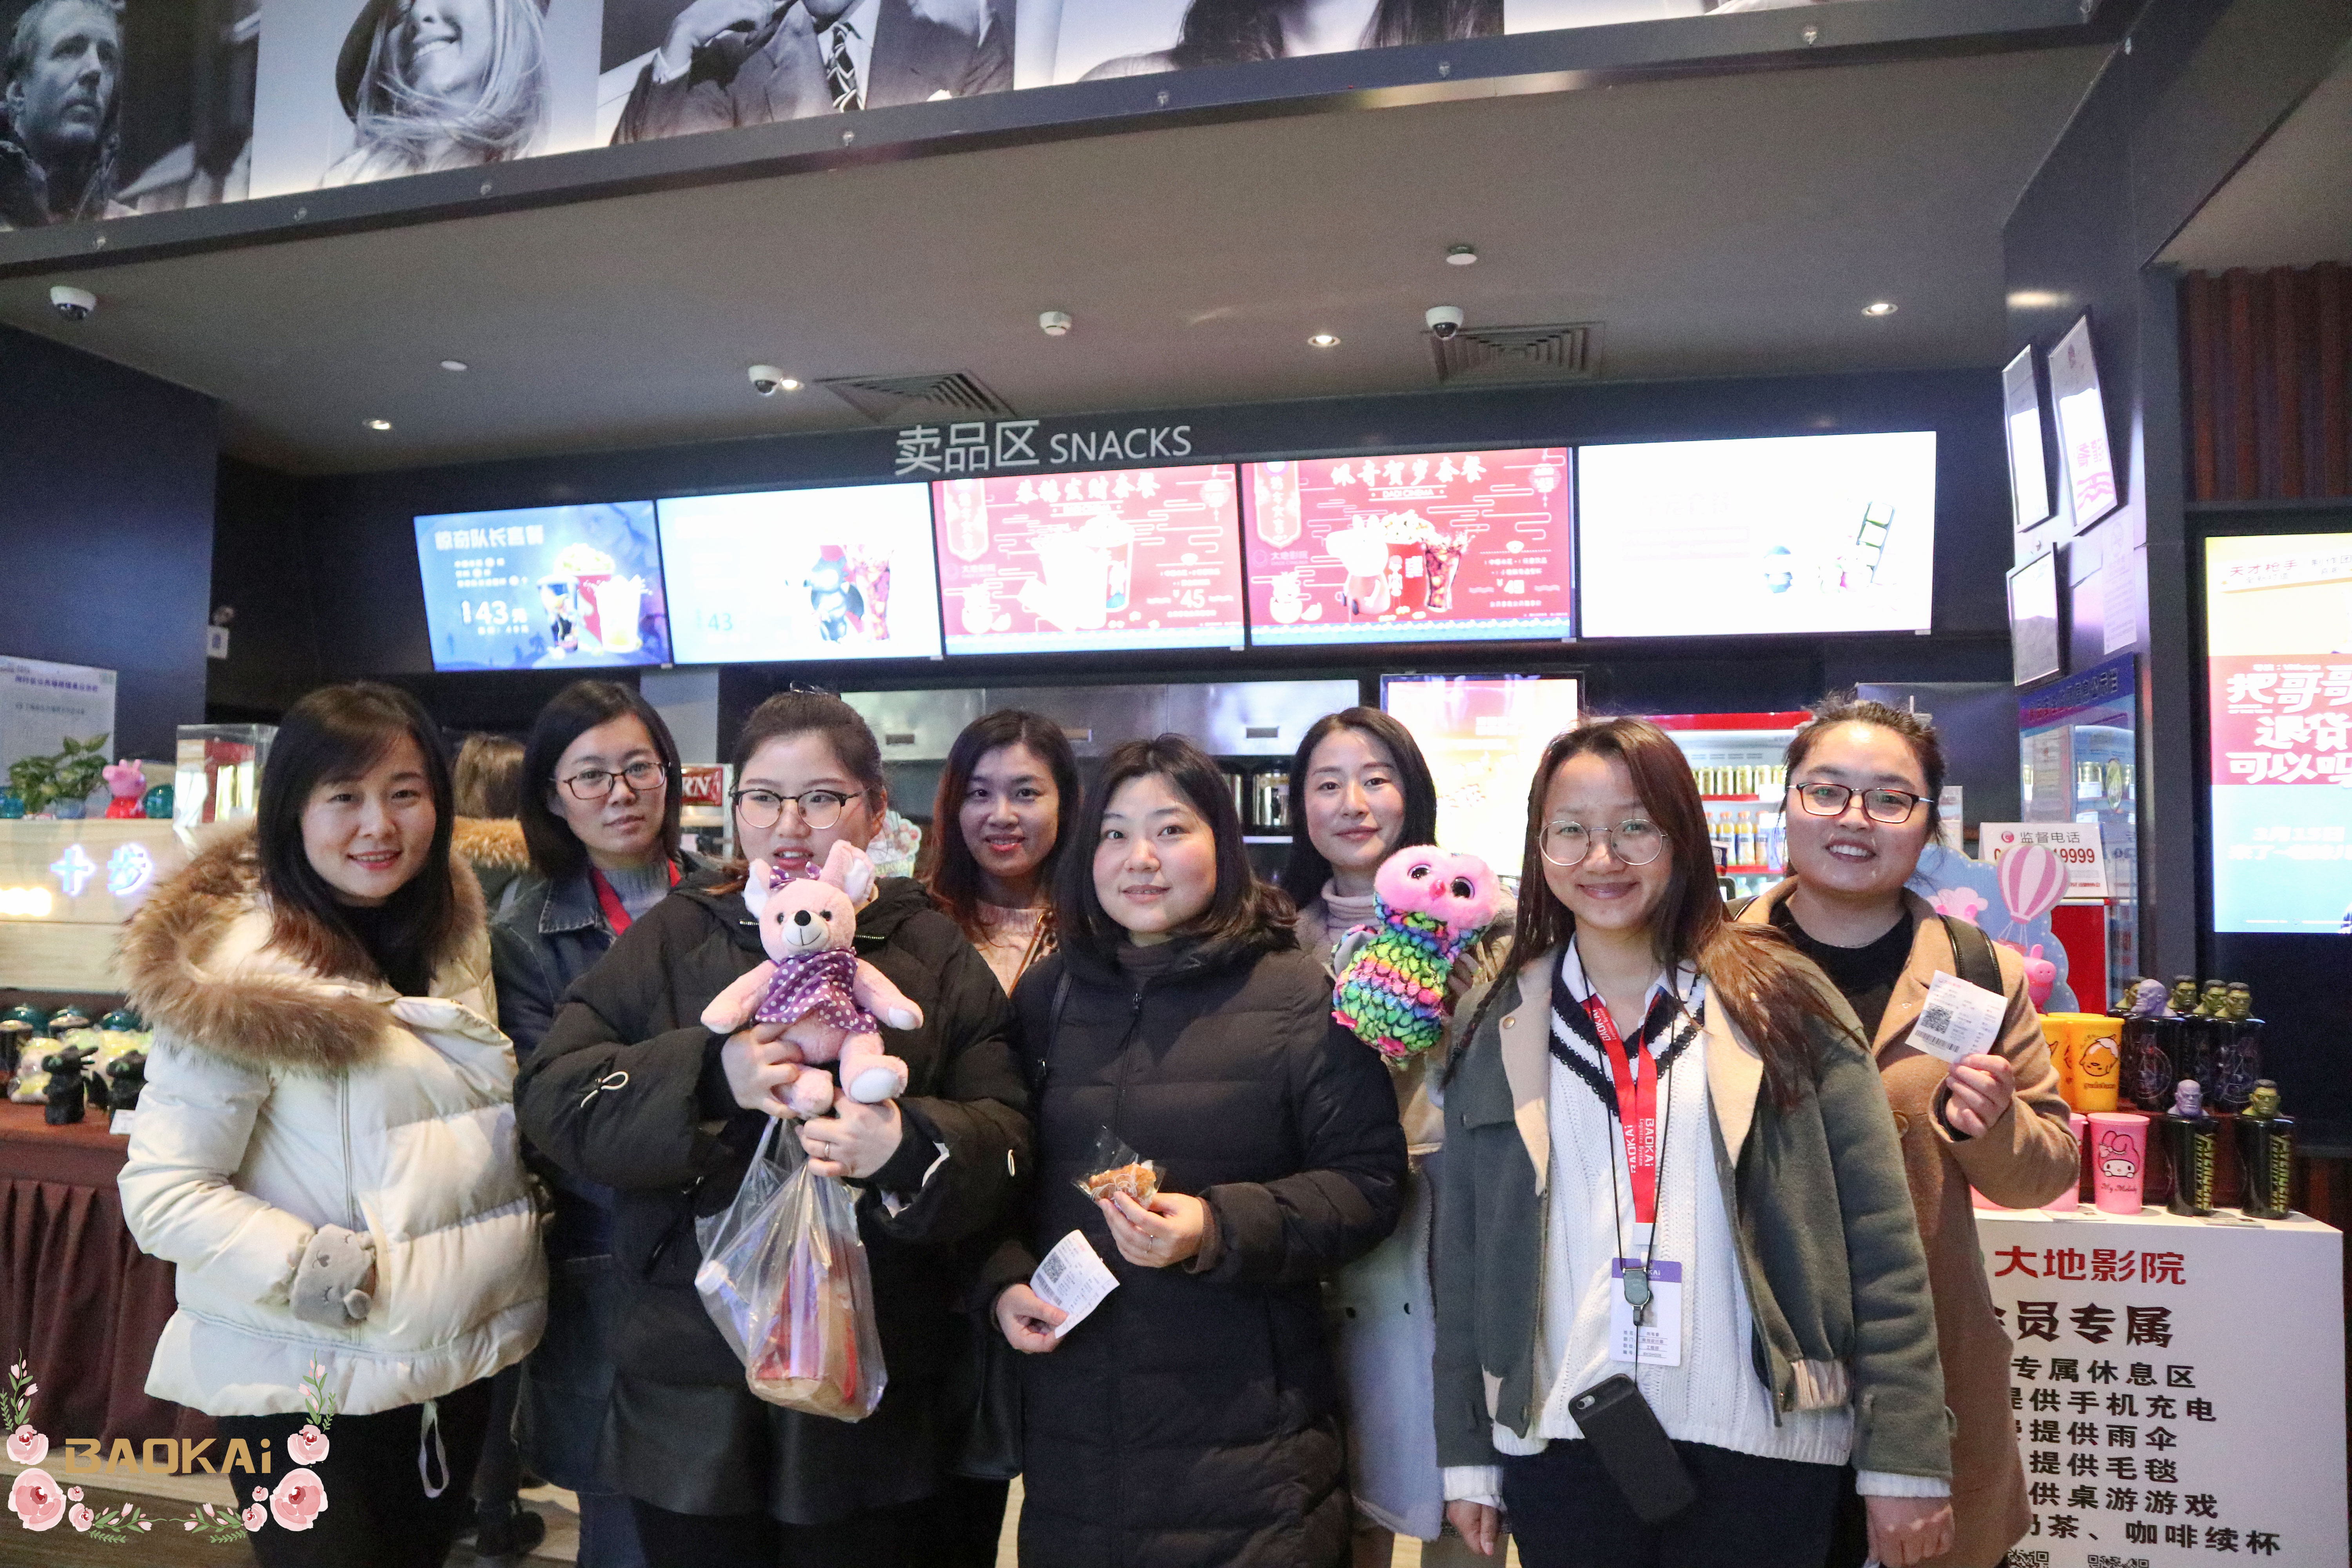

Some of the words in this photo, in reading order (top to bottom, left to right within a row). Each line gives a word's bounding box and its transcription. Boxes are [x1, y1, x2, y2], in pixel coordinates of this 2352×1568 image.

[895, 420, 1039, 475] 卖品区
[1050, 426, 1192, 463] SNACKS
[2020, 832, 2080, 843] 监督电话
[1644, 1118, 1654, 1167] BAOKAi
[1994, 1246, 2186, 1284] 大地影院
[2011, 1356, 2196, 1388] 专属休息区
[2015, 1419, 2178, 1451] 提供雨伞
[2029, 1451, 2179, 1483] 提供毛毯
[2029, 1482, 2218, 1518] 供桌游游戏
[2031, 1514, 2280, 1556] 茶、咖啡续杯
